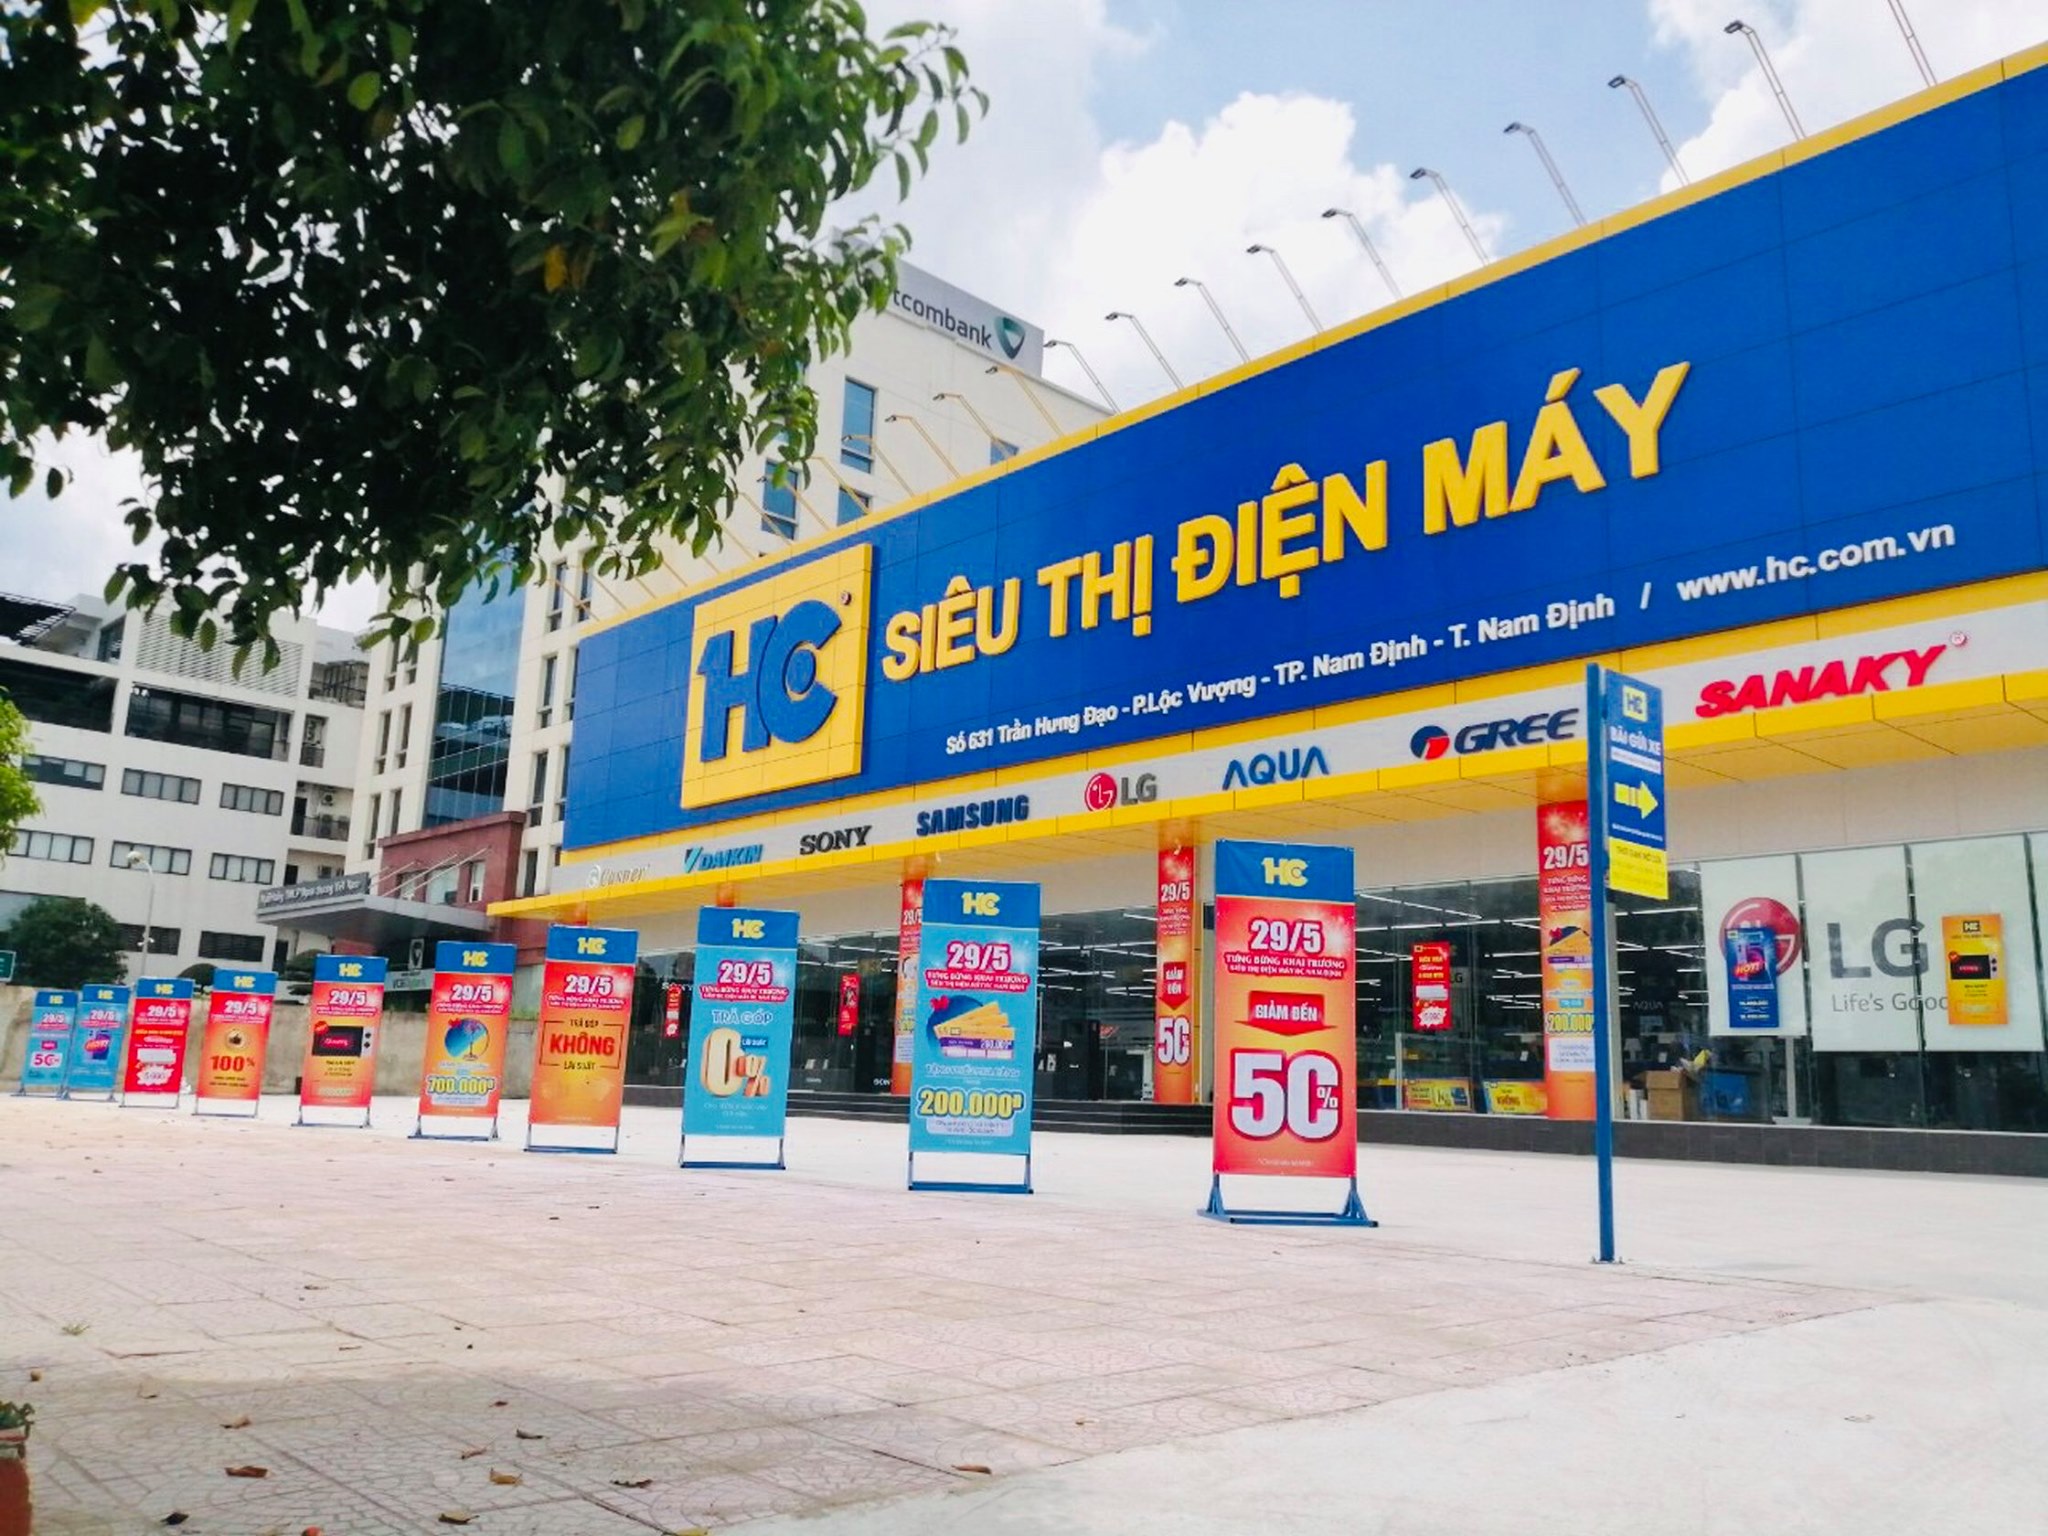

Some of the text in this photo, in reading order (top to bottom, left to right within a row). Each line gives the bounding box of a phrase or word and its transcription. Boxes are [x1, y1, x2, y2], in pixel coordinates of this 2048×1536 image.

[893, 289, 992, 350] tcombank
[882, 361, 1691, 681] SIÊU THỊ ĐIỆN MÁY
[945, 730, 965, 755] Số
[968, 729, 994, 749] 631
[997, 717, 1033, 744] Trần
[1034, 710, 1080, 737] Hưng
[1083, 703, 1118, 728] Đạo
[1131, 688, 1183, 716] P.Lộc
[1186, 674, 1257, 704] Vượng
[1273, 661, 1308, 686] TP.
[1312, 650, 1365, 679] Nam
[1369, 633, 1428, 668] Định
[1448, 623, 1472, 649] T.
[1477, 613, 1540, 644] Nam
[1545, 592, 1616, 630] Định
[1676, 523, 1957, 602] www.hc.com.vn
[696, 599, 843, 763] HC
[1695, 644, 1948, 719] SANAKY
[1454, 707, 1580, 755] GREE
[1221, 746, 1330, 791] AQUA
[1119, 773, 1158, 807] LG
[916, 794, 1031, 837] SAMSUNG
[799, 825, 872, 856] SONY
[700, 844, 764, 869] DAIKIN
[1543, 843, 1590, 870] 29/5
[1261, 857, 1309, 888] HC
[961, 891, 1000, 916] HC
[1161, 882, 1190, 902] 29/5
[731, 918, 765, 939] HC
[1250, 918, 1322, 954] 29/5
[462, 950, 488, 967] HC
[577, 937, 607, 955] HC
[948, 943, 1009, 972] 29/5
[1827, 918, 1929, 979] LG
[719, 961, 771, 985] 29/5
[1283, 958, 1306, 967] KHAI
[329, 989, 366, 1006] 29/5
[451, 983, 492, 1003] 29/5
[564, 974, 612, 996] 29/5
[148, 1005, 177, 1018] 29/5
[224, 1000, 259, 1015] 29/5
[1254, 1000, 1318, 1022] GIẢM ĐẾN
[1832, 992, 1885, 1013] Life's
[712, 1007, 773, 1025] TRẢ GÓP
[550, 1031, 615, 1056] KHÔNG
